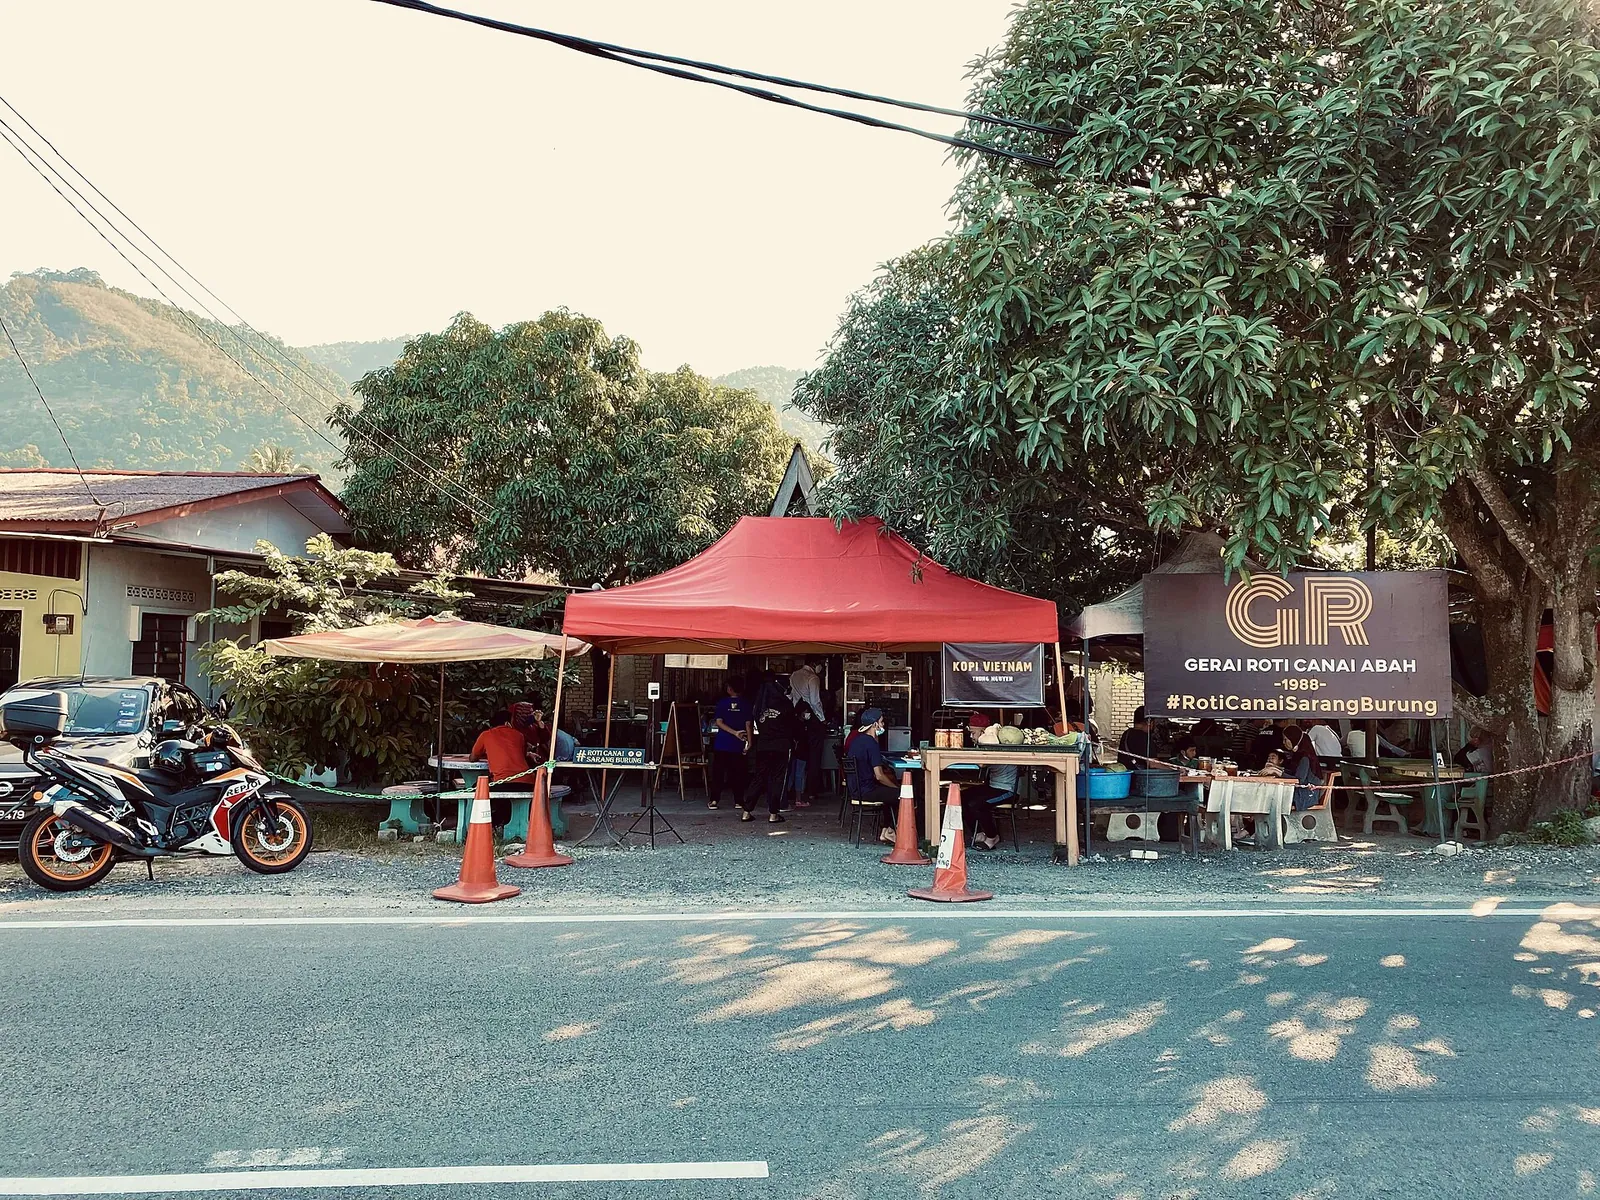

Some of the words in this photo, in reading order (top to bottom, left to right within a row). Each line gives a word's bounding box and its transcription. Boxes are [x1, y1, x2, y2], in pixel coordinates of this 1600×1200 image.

[1225, 573, 1373, 648] GR
[952, 661, 979, 672] KOPI
[983, 661, 1033, 672] VIETNAM
[1184, 658, 1242, 672] GERAI
[1246, 658, 1289, 672] ROTI
[1293, 658, 1356, 673] CANAI
[1360, 659, 1416, 673] ABAH
[1273, 678, 1327, 691] -1988-
[1166, 693, 1438, 717] #RotiCanaiSarangBurung
